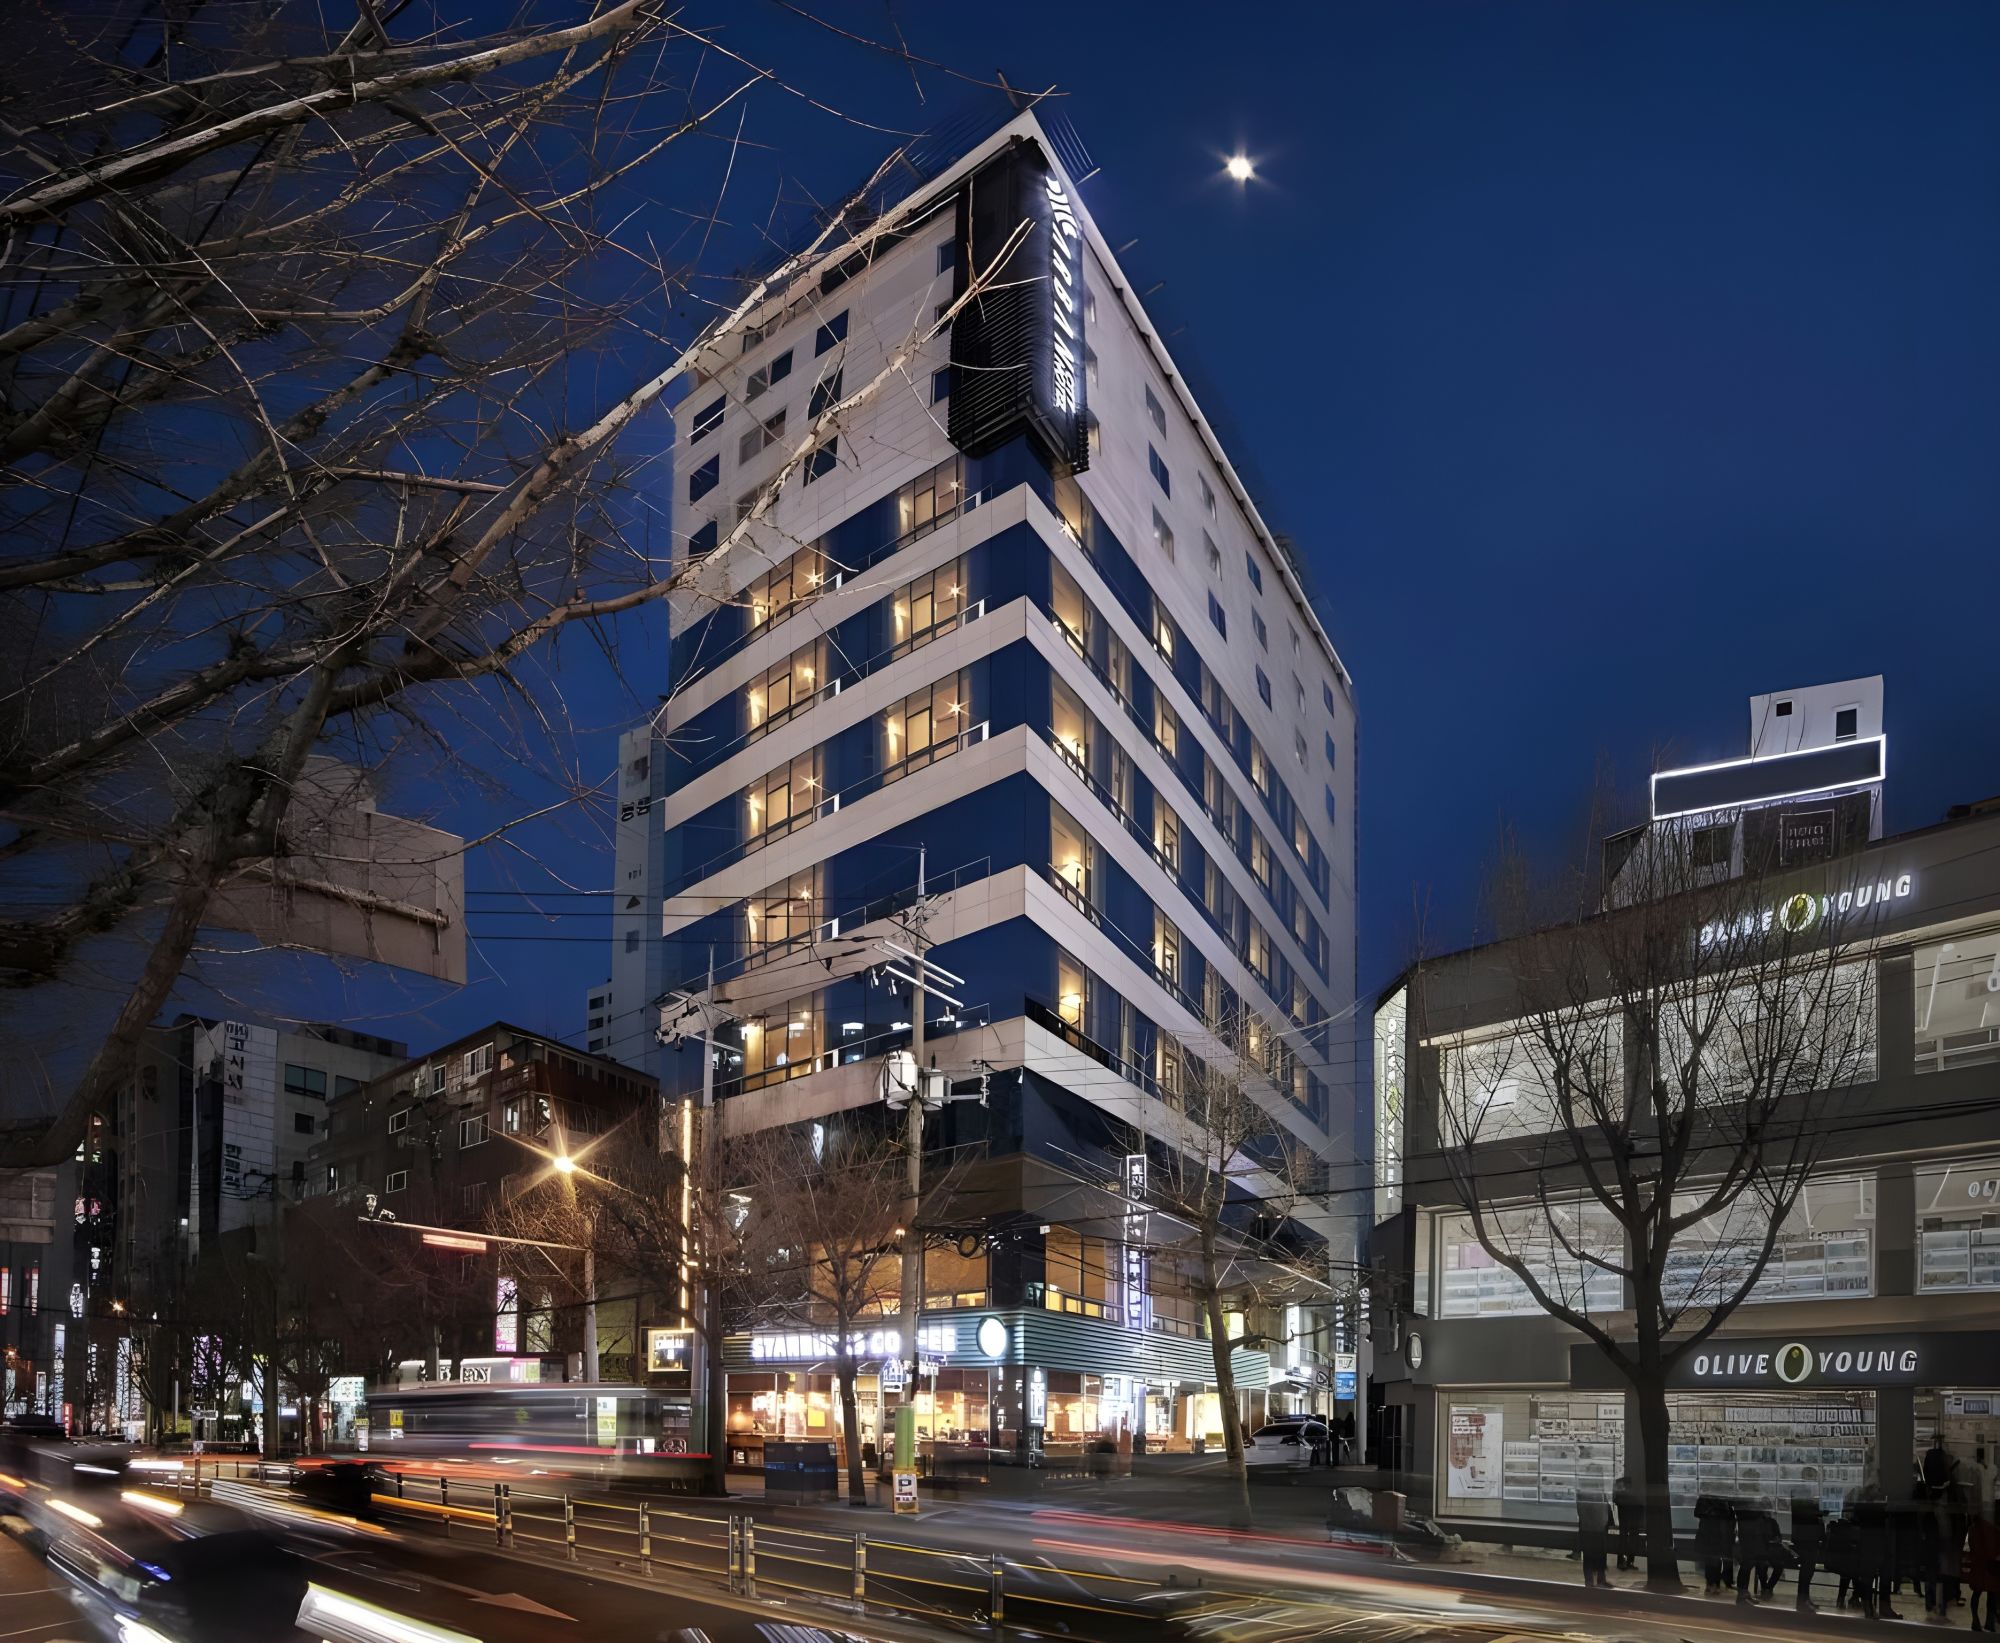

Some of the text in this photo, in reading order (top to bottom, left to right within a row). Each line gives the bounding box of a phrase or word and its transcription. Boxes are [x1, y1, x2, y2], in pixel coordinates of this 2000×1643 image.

[870, 1325, 956, 1354] COFEE
[1693, 1350, 1918, 1375] OLIVE YOUNG
